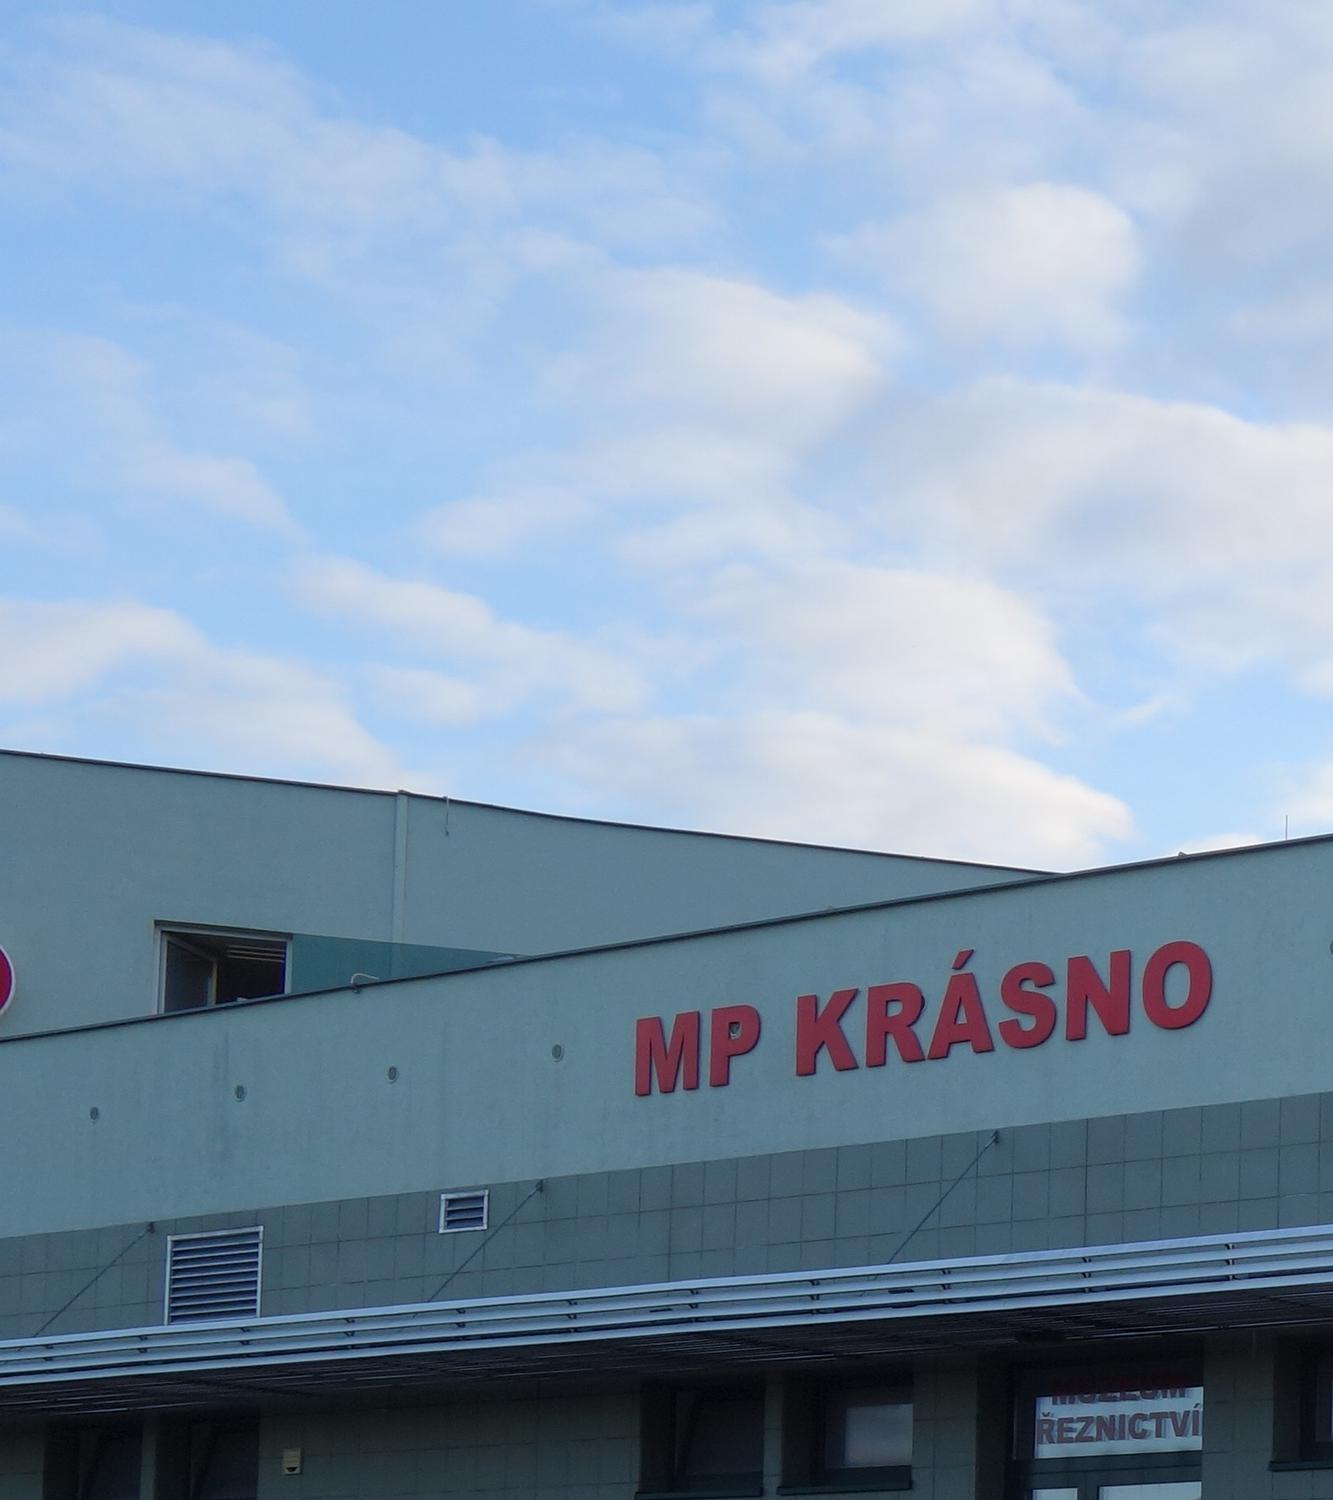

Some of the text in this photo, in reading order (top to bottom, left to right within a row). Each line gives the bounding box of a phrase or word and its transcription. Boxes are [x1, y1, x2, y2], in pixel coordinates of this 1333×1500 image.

[635, 940, 1213, 1097] MP KRÁSNO
[1037, 1402, 1201, 1444] ŘEZNICTVÍ
